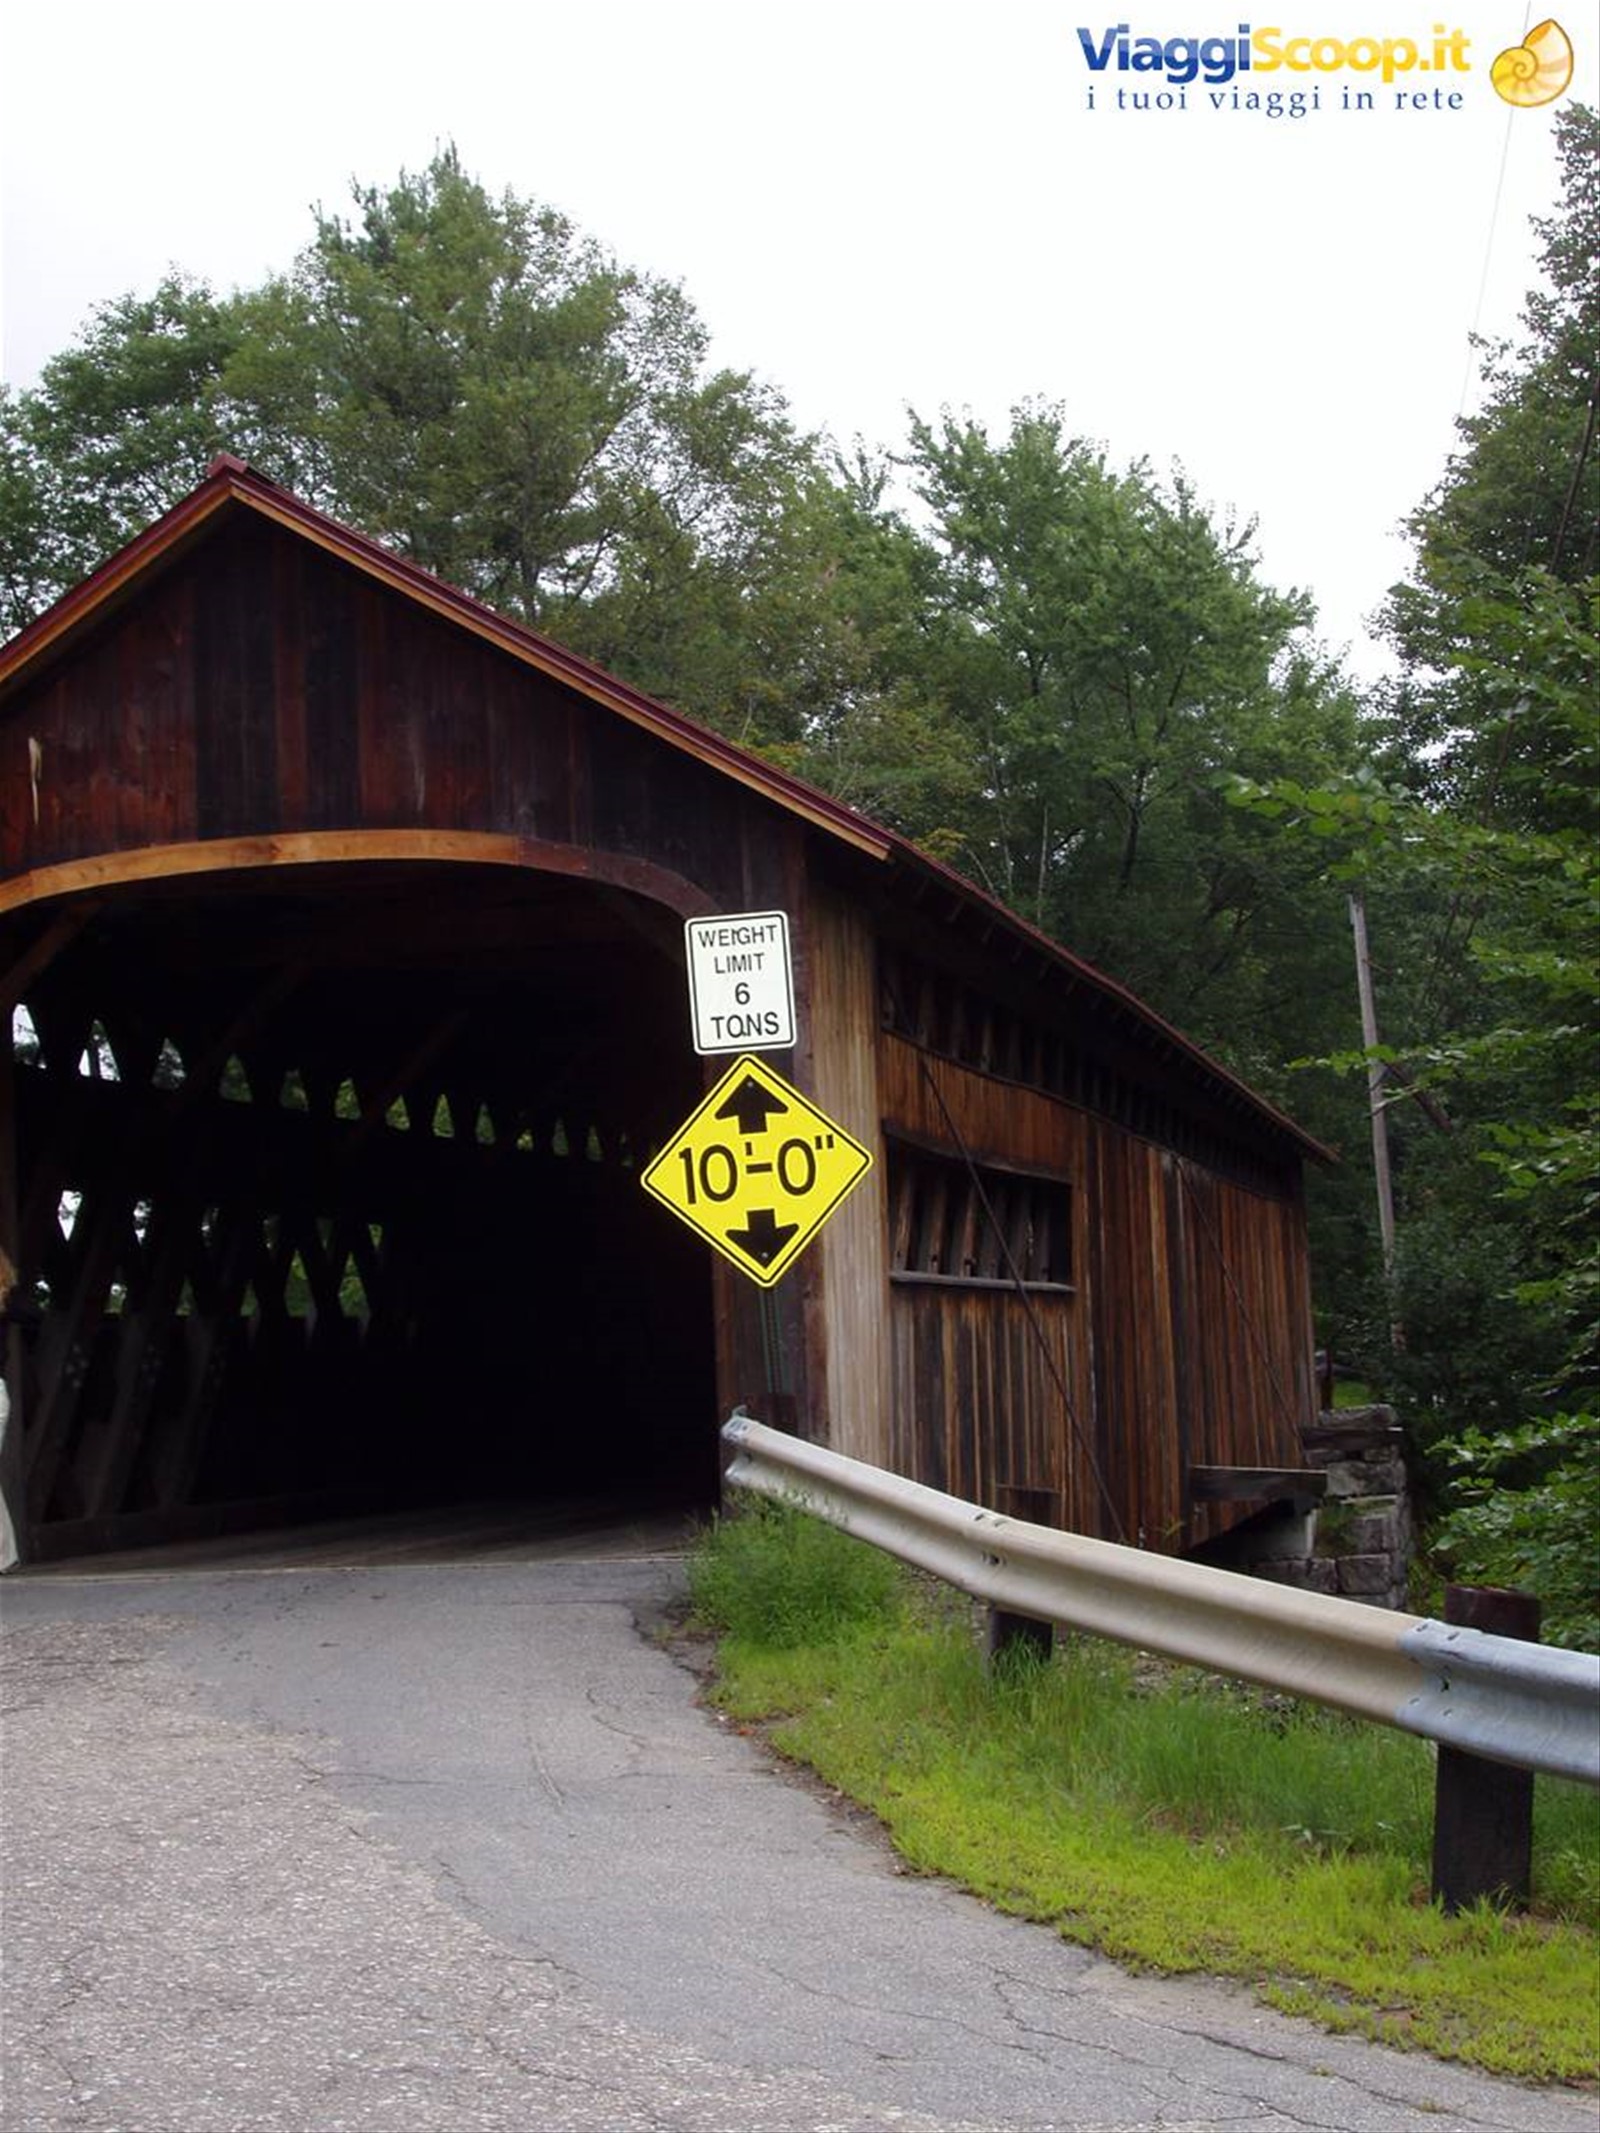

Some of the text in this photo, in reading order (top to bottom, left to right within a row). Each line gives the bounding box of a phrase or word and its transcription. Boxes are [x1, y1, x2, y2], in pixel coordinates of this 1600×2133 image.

[698, 925, 777, 948] WEIGHT
[714, 952, 764, 974] LIMIT
[735, 982, 750, 1005] 6
[710, 1011, 779, 1040] TONS
